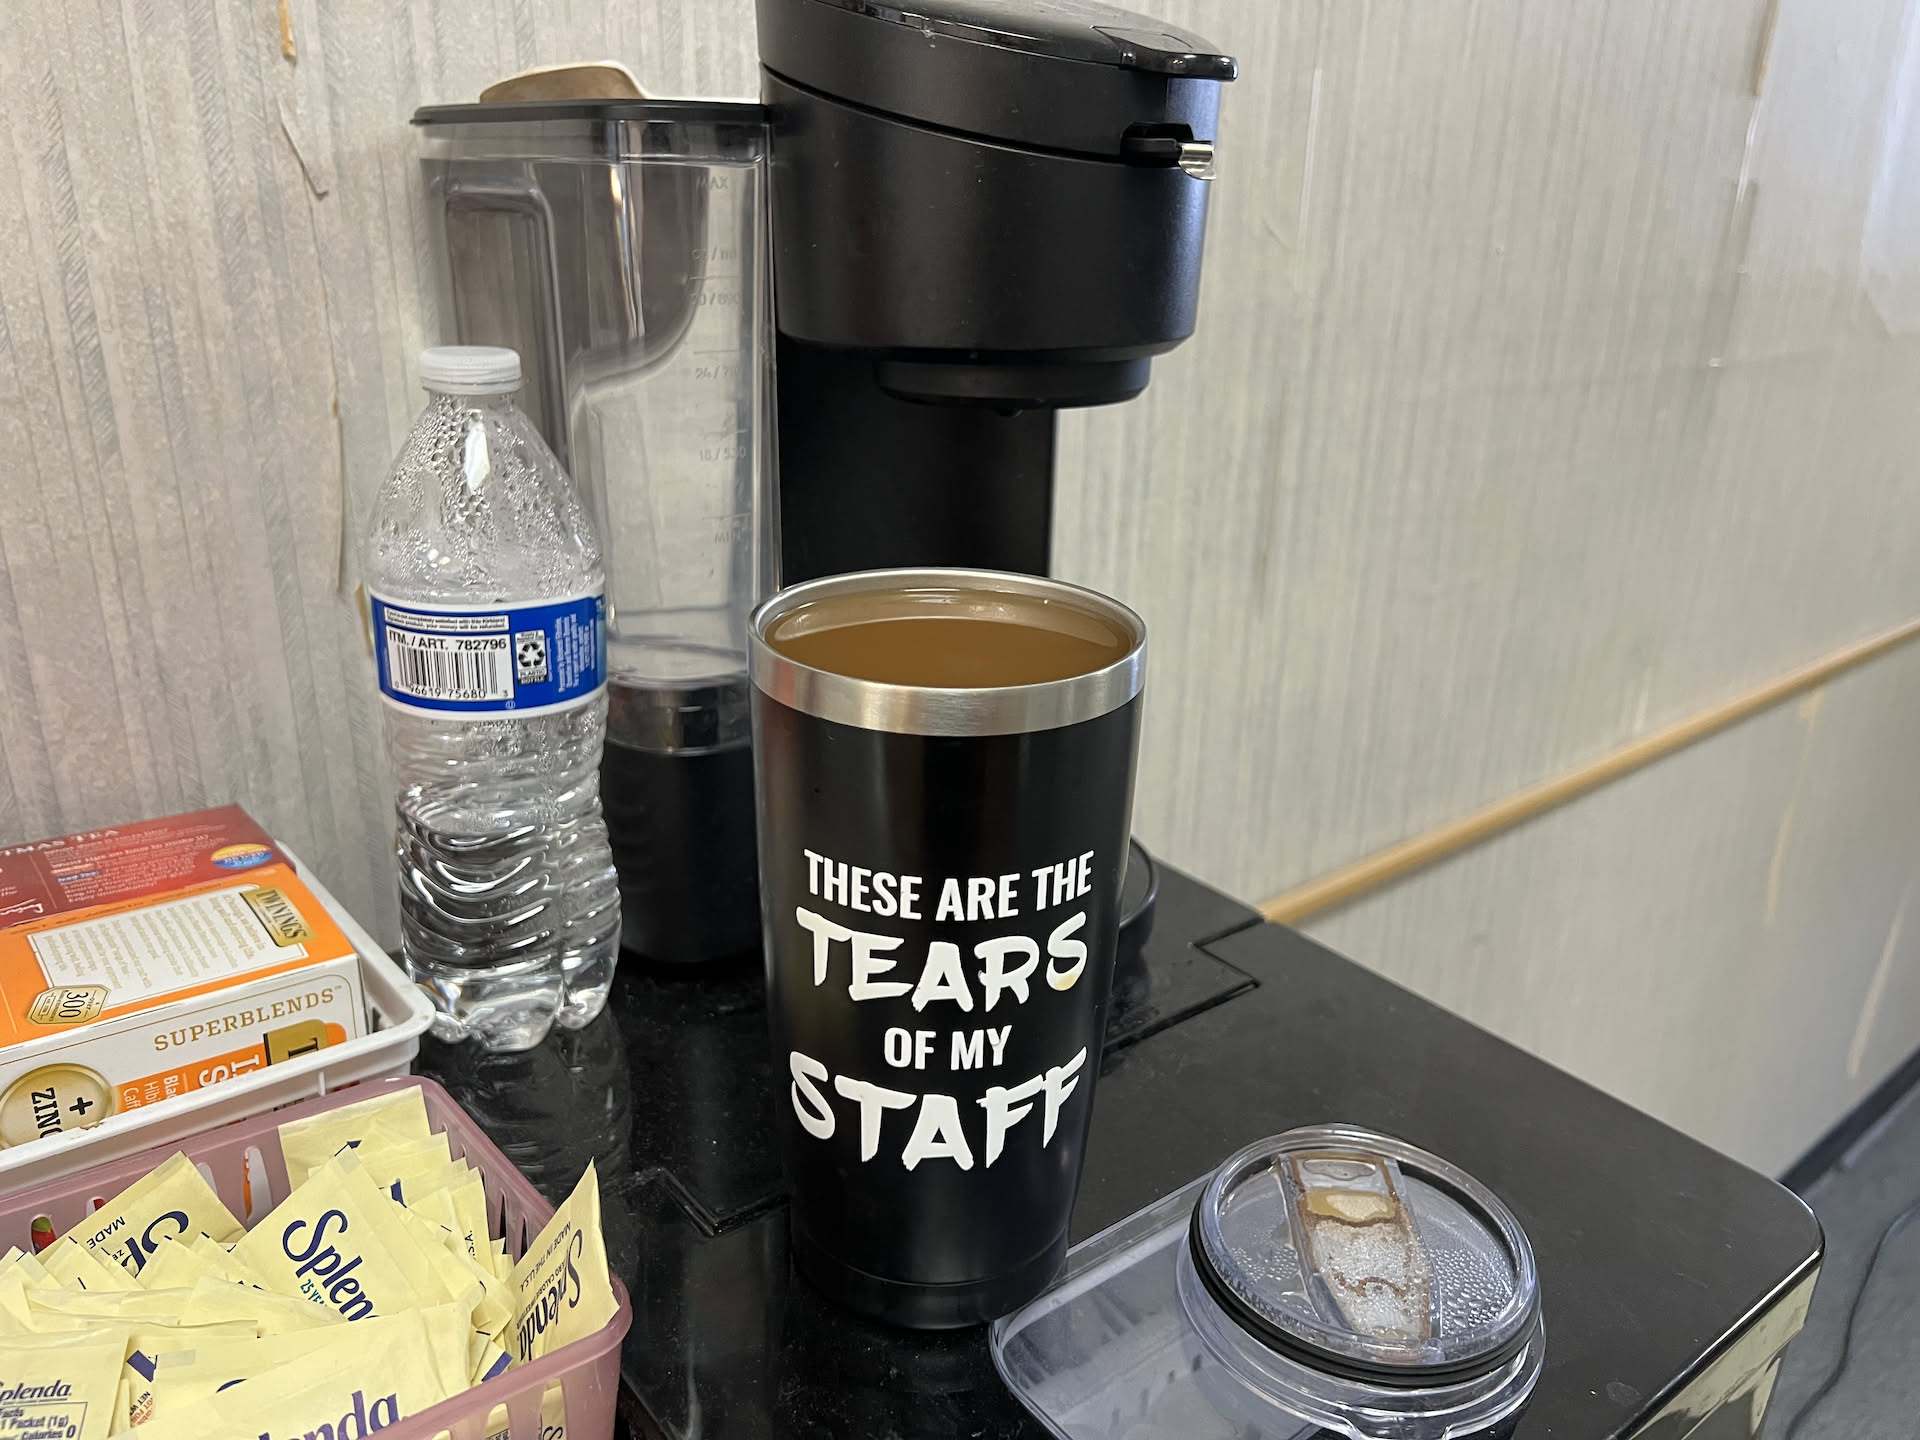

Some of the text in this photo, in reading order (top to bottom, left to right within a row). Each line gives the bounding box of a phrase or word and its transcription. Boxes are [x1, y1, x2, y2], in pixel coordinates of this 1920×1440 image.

[389, 630, 409, 647] ITM.
[418, 637, 448, 650] ART.
[456, 637, 507, 650] 782796
[410, 685, 441, 698] 96619
[448, 688, 486, 699] 75680
[804, 849, 1095, 922] THESE ARE THE
[256, 889, 307, 938] TWININGS
[796, 906, 1088, 1013] TEARS
[58, 991, 88, 1018] 300
[884, 1024, 1013, 1071] OF MY
[124, 1087, 141, 1109] Caff
[144, 1080, 161, 1104] Hibi
[163, 1075, 180, 1099] Blac
[789, 1046, 1088, 1172] STAFF
[86, 1216, 126, 1249] MADE
[554, 1221, 571, 1250] MADE
[112, 1249, 125, 1261] ZE
[282, 1209, 380, 1322] Splen
[535, 1254, 546, 1272] THE
[300, 1278, 315, 1294] 25
[308, 1289, 327, 1307] YE
[138, 1391, 151, 1406] NET
